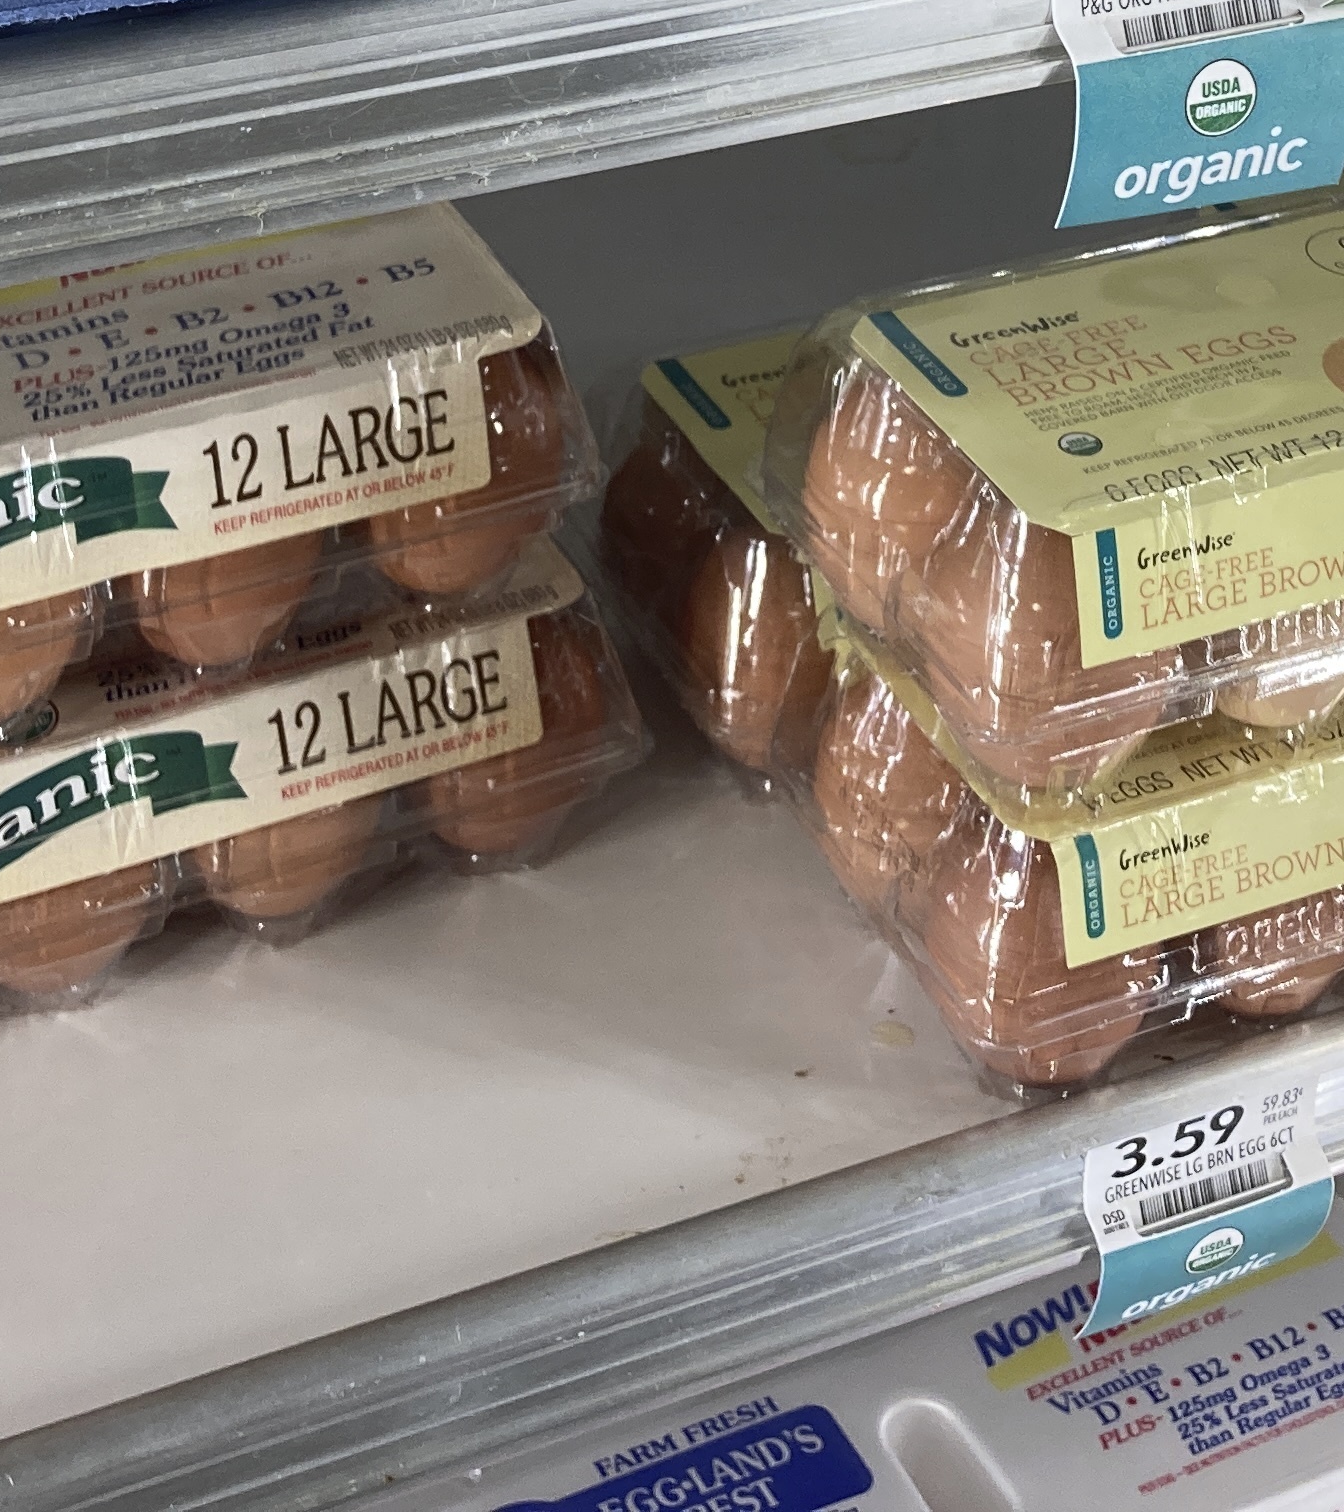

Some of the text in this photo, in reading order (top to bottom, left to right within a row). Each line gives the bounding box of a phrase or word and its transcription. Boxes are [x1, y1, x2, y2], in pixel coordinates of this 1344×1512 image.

[1194, 99, 1247, 122] ORGANIC
[1201, 76, 1241, 98] USDA
[1113, 126, 1308, 205] organic
[176, 329, 319, 372] Saturated
[219, 313, 322, 344] Omega
[949, 311, 1080, 348] GreenWise
[983, 338, 1138, 389] LARGE
[1006, 352, 1175, 407] BROWN
[1176, 326, 1298, 366] EGGS
[203, 431, 263, 509] 12
[277, 389, 455, 491] LARGE
[250, 492, 343, 526] REFRIGERATED
[1137, 532, 1235, 570] GreenWise
[1139, 546, 1275, 600] CAGE-FREE
[1105, 555, 1120, 631] ORGANIC
[1141, 578, 1248, 631] LARGE
[267, 700, 326, 775] 12
[337, 649, 508, 754] LARGE
[315, 752, 404, 790] REFRIGERATED
[1118, 830, 1211, 872] GreenWise
[1119, 844, 1250, 900] CAGE-FREE
[1086, 858, 1101, 930] ORGANIC
[1121, 874, 1225, 928] LARGE
[1104, 1125, 1296, 1204] GREENWISE LG BRN EGG 6CT
[1111, 1104, 1245, 1179] 3.59
[1102, 1209, 1126, 1227] DSD
[1200, 1236, 1233, 1256] USDA
[1120, 1251, 1278, 1320] organic
[973, 1284, 1091, 1368] NOW!
[1025, 1348, 1126, 1401] EXCELLENT
[1130, 1315, 1203, 1357] SOURCE
[1184, 1357, 1231, 1387] B2
[1245, 1325, 1306, 1361] B12
[1046, 1363, 1163, 1415] Vitamins
[1167, 1356, 1312, 1423] 125mg Omega
[1237, 1393, 1313, 1436] Regular
[593, 1396, 781, 1478] FARM FRESH
